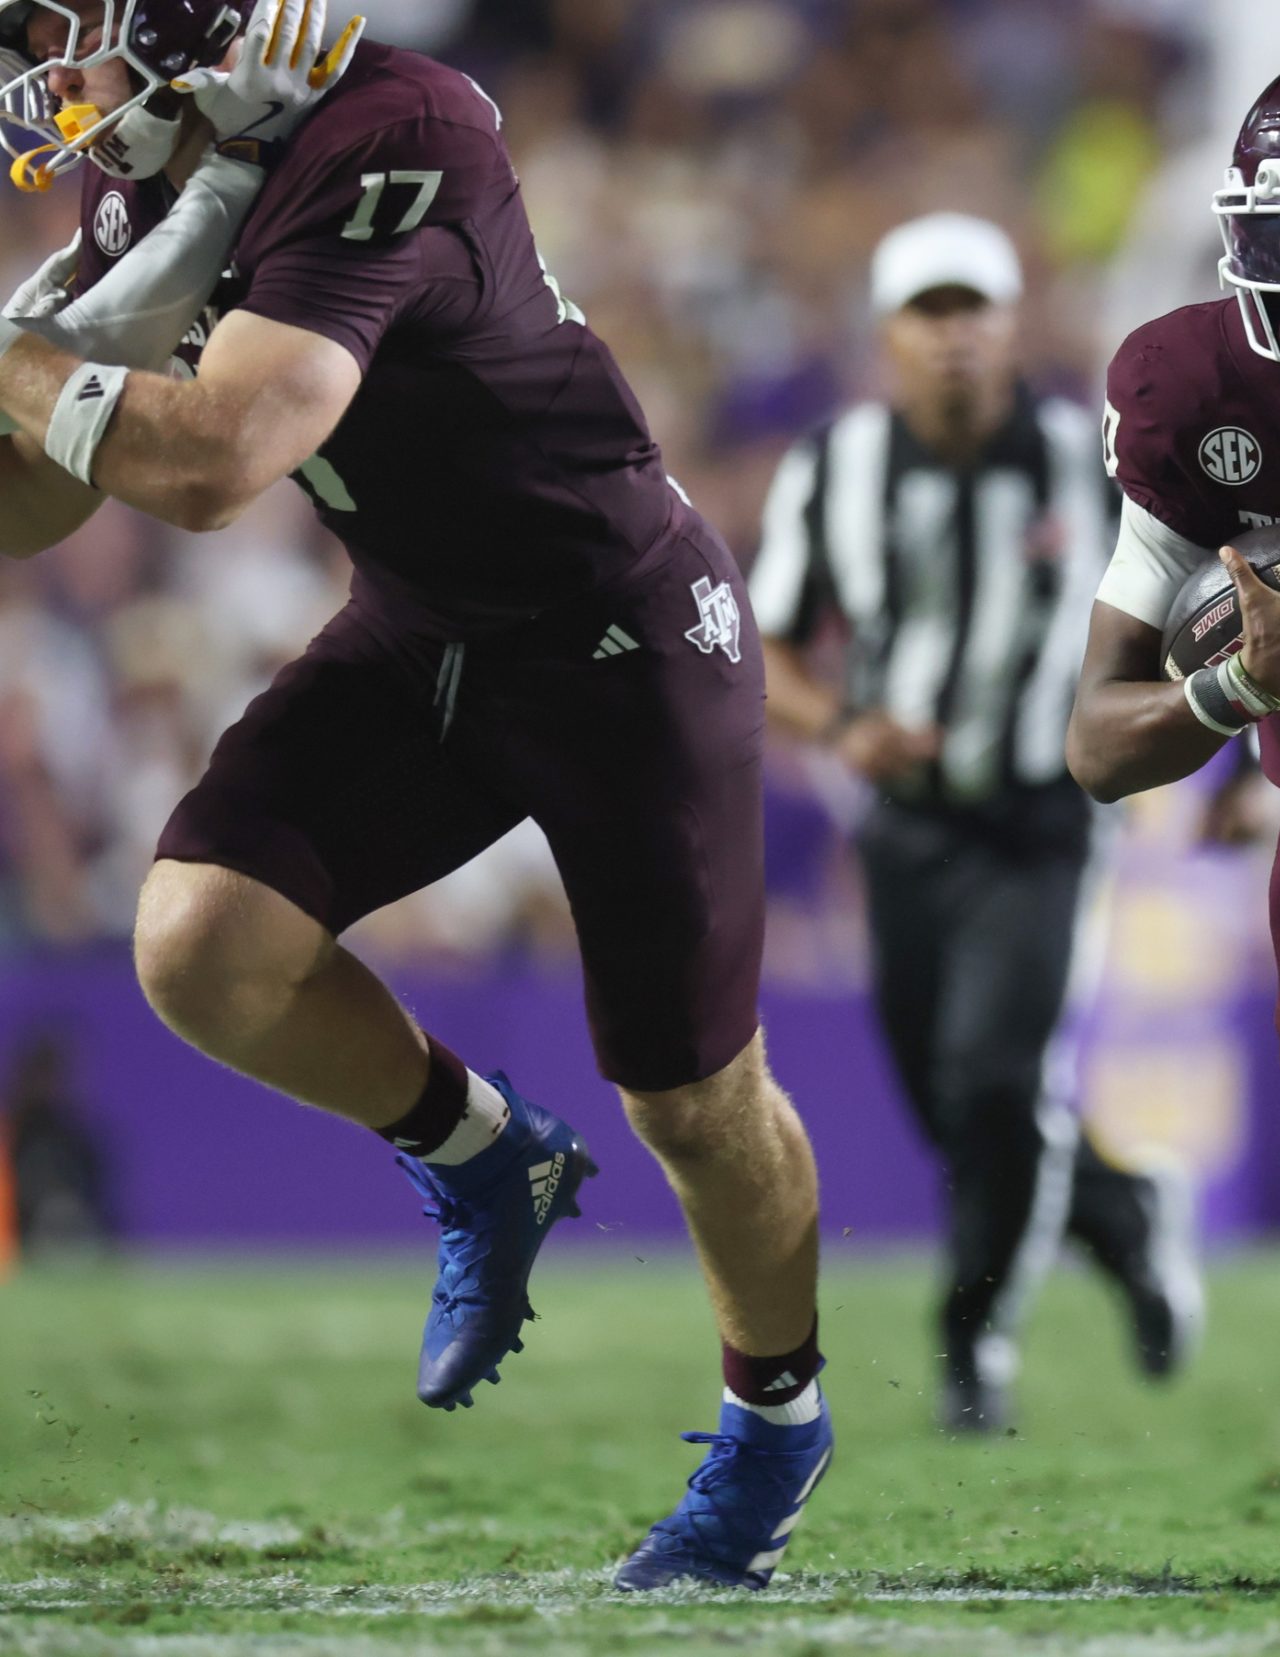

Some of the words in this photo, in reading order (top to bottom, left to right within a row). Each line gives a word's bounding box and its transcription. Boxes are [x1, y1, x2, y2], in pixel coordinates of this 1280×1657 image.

[97, 196, 129, 252] SEC
[340, 170, 444, 241] 17
[1203, 430, 1257, 482] SEC
[1192, 596, 1234, 642] DIME
[536, 1151, 566, 1225] adidas
